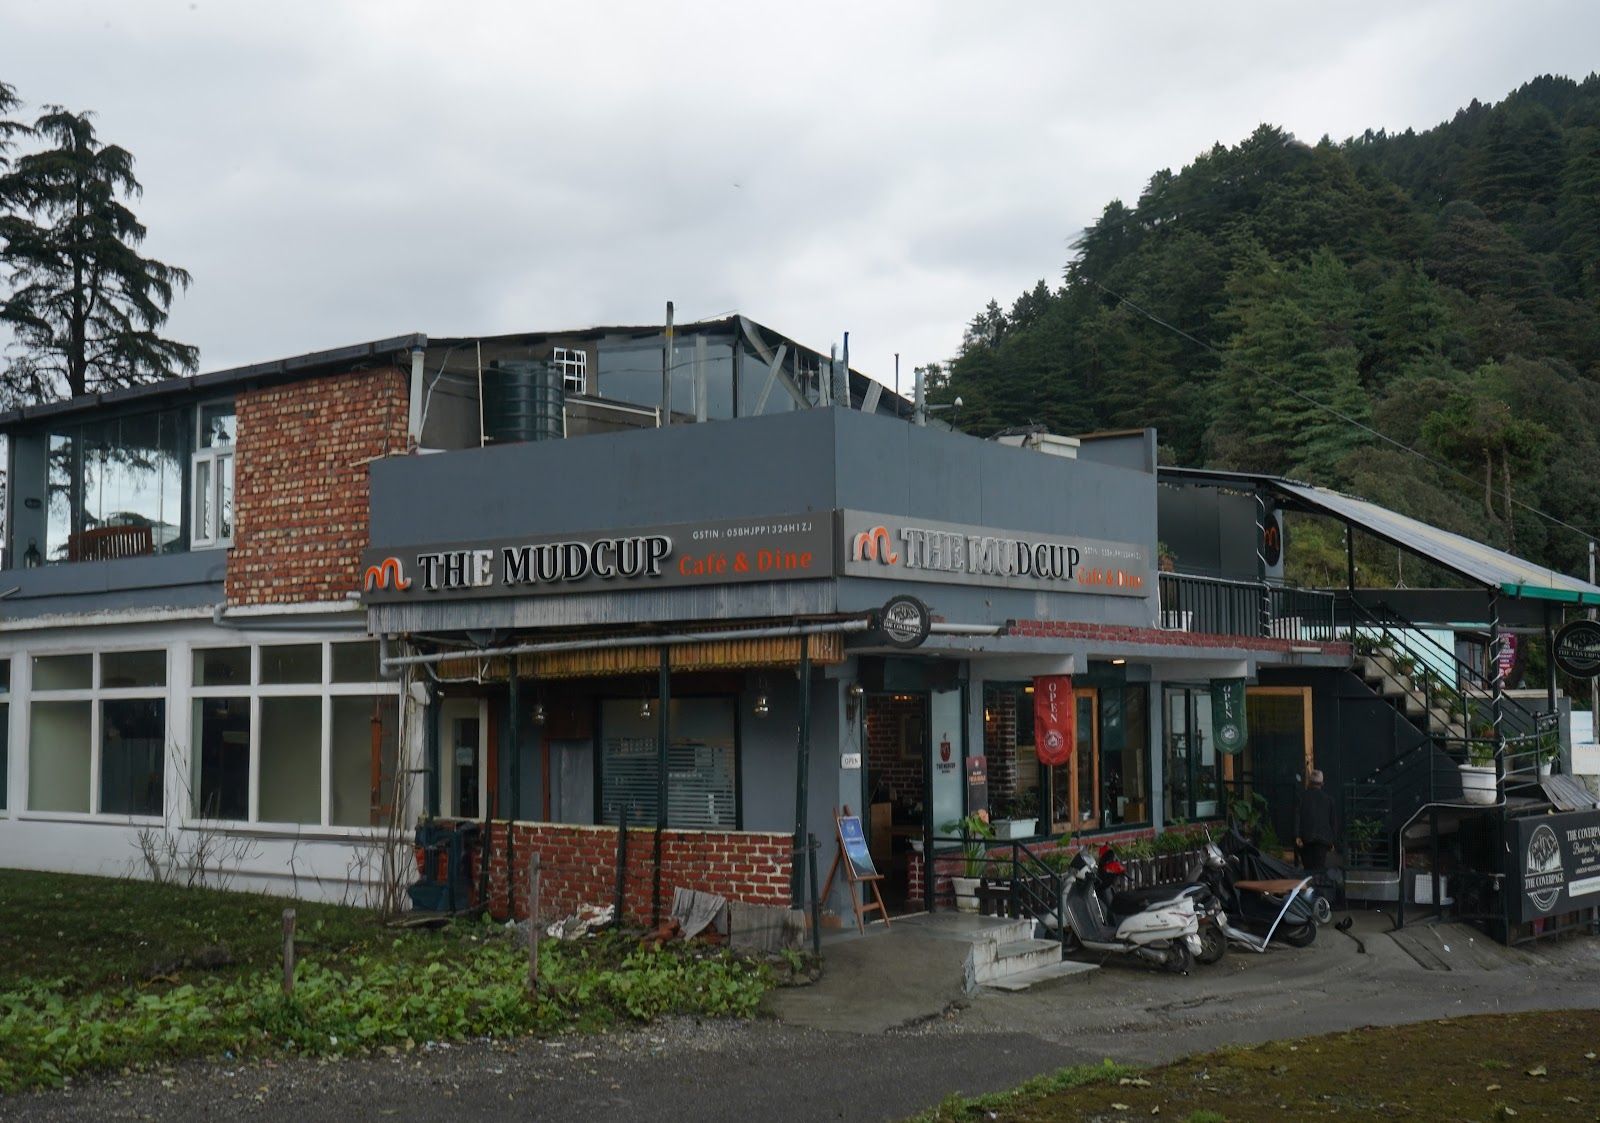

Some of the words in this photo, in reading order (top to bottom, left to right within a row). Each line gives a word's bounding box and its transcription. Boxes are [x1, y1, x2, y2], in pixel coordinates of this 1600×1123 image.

[692, 530, 719, 540] GSTIN
[900, 527, 965, 572] THE
[966, 535, 1080, 581] MUDCUP
[416, 549, 494, 591] THE
[501, 535, 673, 586] MUDCUP
[679, 551, 728, 577] Café
[733, 551, 750, 573] &
[756, 547, 813, 572] Dine
[1048, 682, 1058, 724] OPEN
[1223, 685, 1233, 719] OPEN
